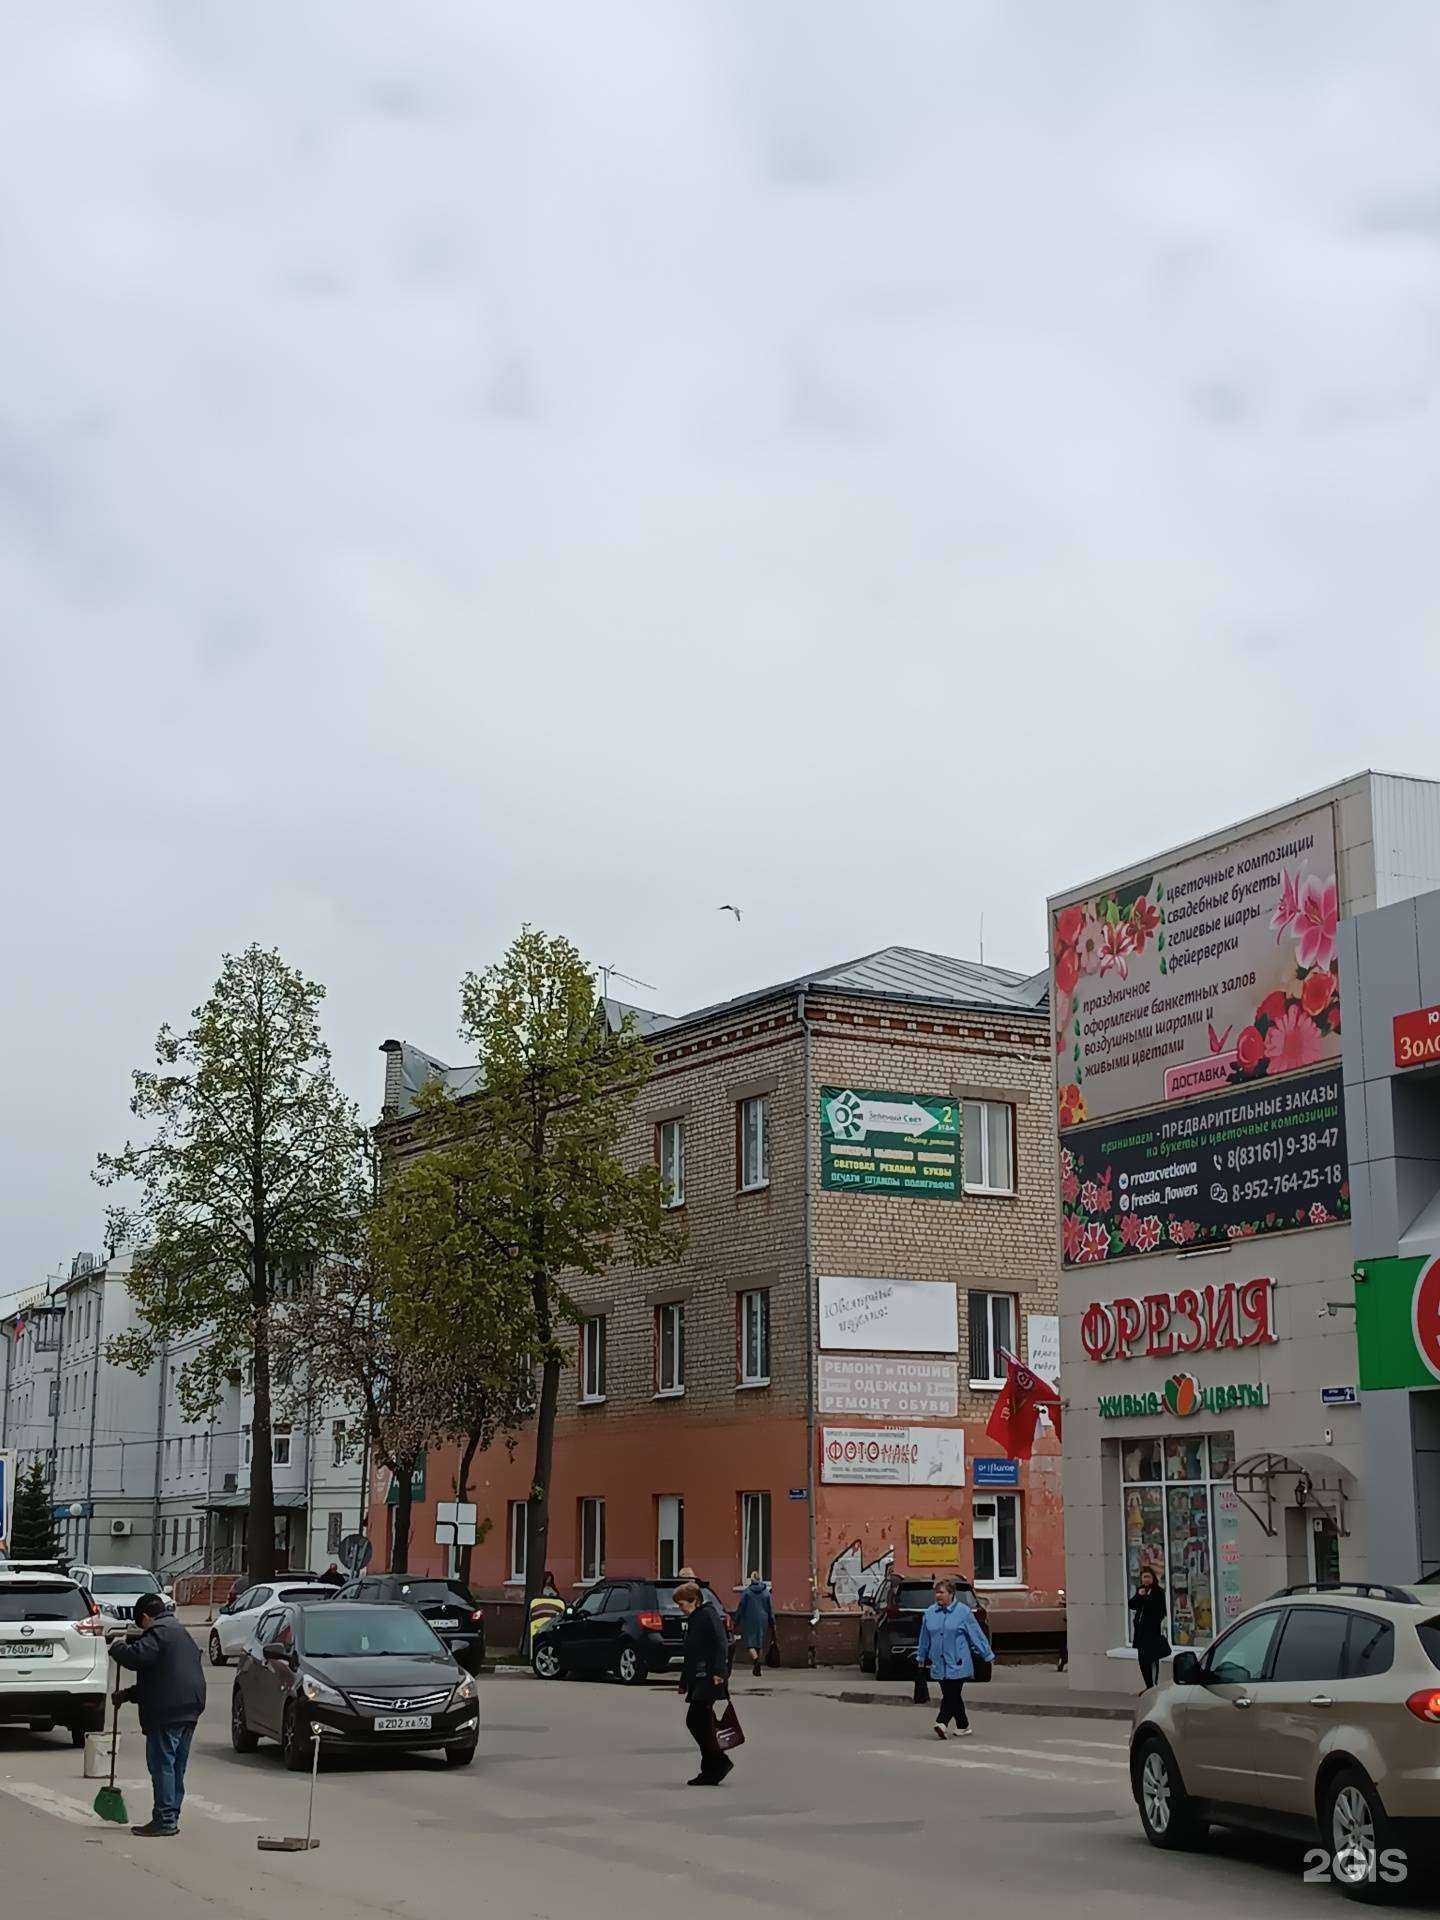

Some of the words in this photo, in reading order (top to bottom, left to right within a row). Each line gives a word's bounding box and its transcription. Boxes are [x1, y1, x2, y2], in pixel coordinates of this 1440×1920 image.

[1167, 865, 1234, 901] цветочные
[1237, 835, 1314, 876] композиции
[1167, 891, 1228, 924] свадебные
[1232, 873, 1281, 904] букеты
[1168, 916, 1220, 946] гелиевые
[1224, 904, 1260, 928] шары
[1169, 936, 1238, 973] фейерверки
[1082, 980, 1150, 1015] праздничное
[1084, 1005, 1149, 1036] оформление
[1151, 983, 1219, 1014] банкетных
[1222, 972, 1256, 994] залов
[1084, 1025, 1153, 1056] воздушными
[1156, 1010, 1203, 1034] шарами
[1206, 1006, 1214, 1021] и
[1084, 1056, 1130, 1077] живыми
[1132, 1039, 1184, 1066] цветами
[1172, 1065, 1227, 1092] ДОСТАВКА
[942, 1106, 952, 1123] 2
[1101, 1132, 1153, 1154] принимаем
[1162, 1097, 1282, 1139] ПРЕДВАРИТЕЛЬНЫЕ
[1286, 1083, 1338, 1110] ЗАКАЗЫ
[1146, 1146, 1158, 1157] на
[1160, 1138, 1198, 1157] букеты
[1209, 1121, 1269, 1146] цветочные
[1271, 1106, 1338, 1130] композиции
[1228, 1137, 1283, 1172] 8(83161)
[1286, 1128, 1339, 1156] 9-38-47
[1232, 1164, 1342, 1202] 8-952-764-25-18
[1081, 1278, 1278, 1361] ФРЕЗИЯ
[825, 1362, 882, 1374] РЕМОНТ
[897, 1364, 950, 1378] ПОШИВ
[854, 1380, 920, 1394] ОДЕЖДЫ
[825, 1396, 890, 1410] РЕМОНТ
[899, 1400, 950, 1412] ОБУВИ
